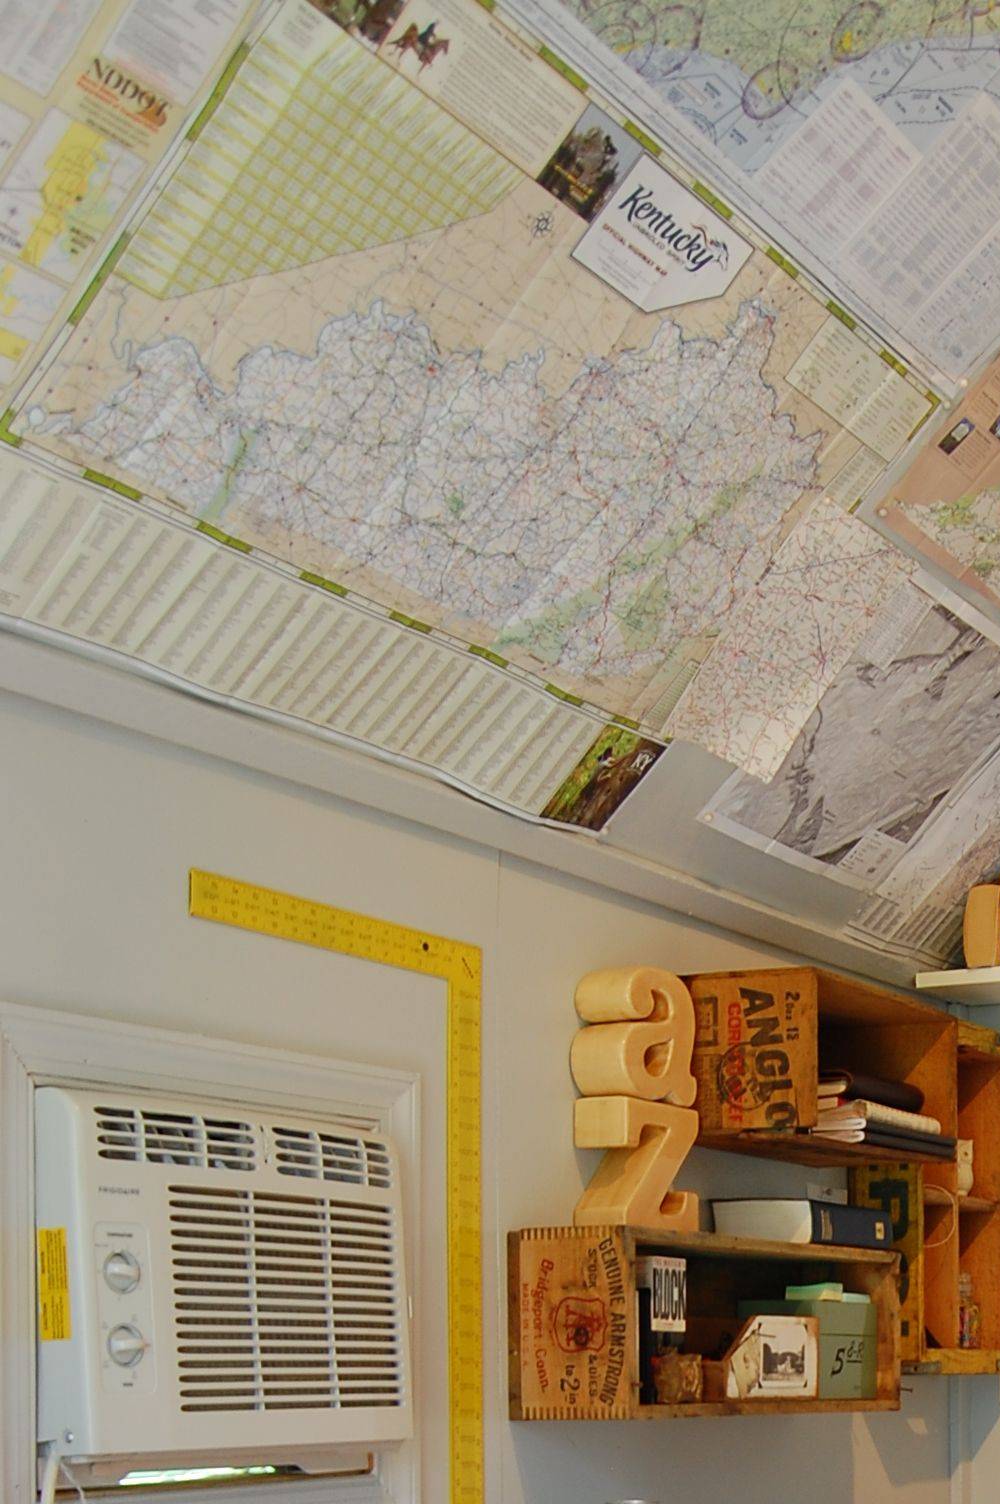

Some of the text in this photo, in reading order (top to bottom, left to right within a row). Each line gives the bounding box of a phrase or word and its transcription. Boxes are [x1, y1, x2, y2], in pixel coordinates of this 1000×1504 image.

[619, 184, 714, 272] Kentucky
[739, 987, 797, 1127] ANGLO
[598, 1237, 626, 1406] GENUINE ARMSTRONG
[653, 1267, 688, 1321] BLOCK
[560, 1378, 580, 1392] 2
[566, 1365, 575, 1376] to
